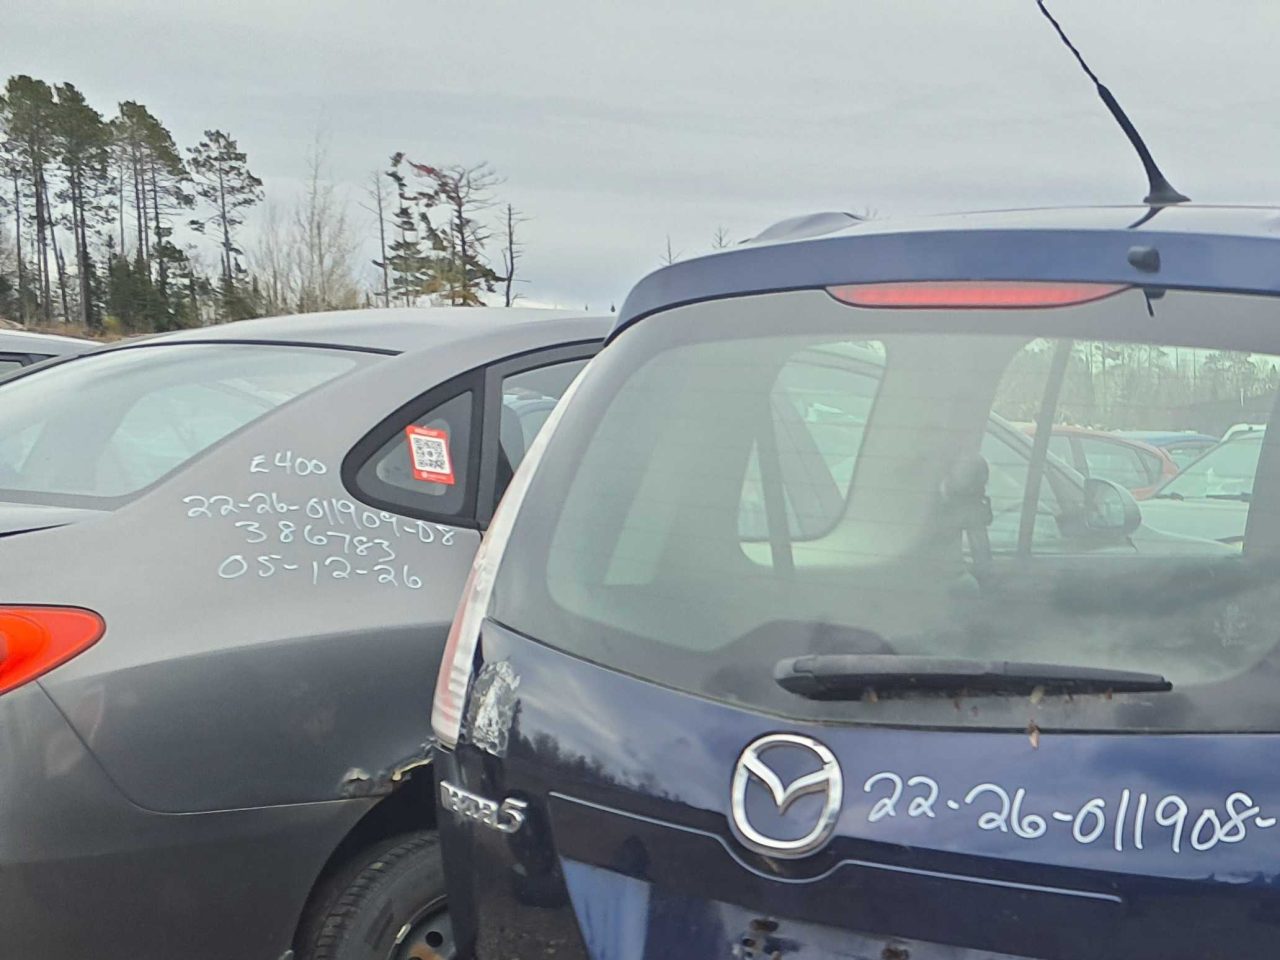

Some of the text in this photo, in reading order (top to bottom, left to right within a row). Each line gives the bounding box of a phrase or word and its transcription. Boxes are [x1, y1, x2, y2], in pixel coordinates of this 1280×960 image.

[250, 451, 327, 476] E400
[182, 492, 456, 546] 22-26-011909-08
[235, 521, 396, 562] 386783
[218, 554, 422, 589] 05-12-26
